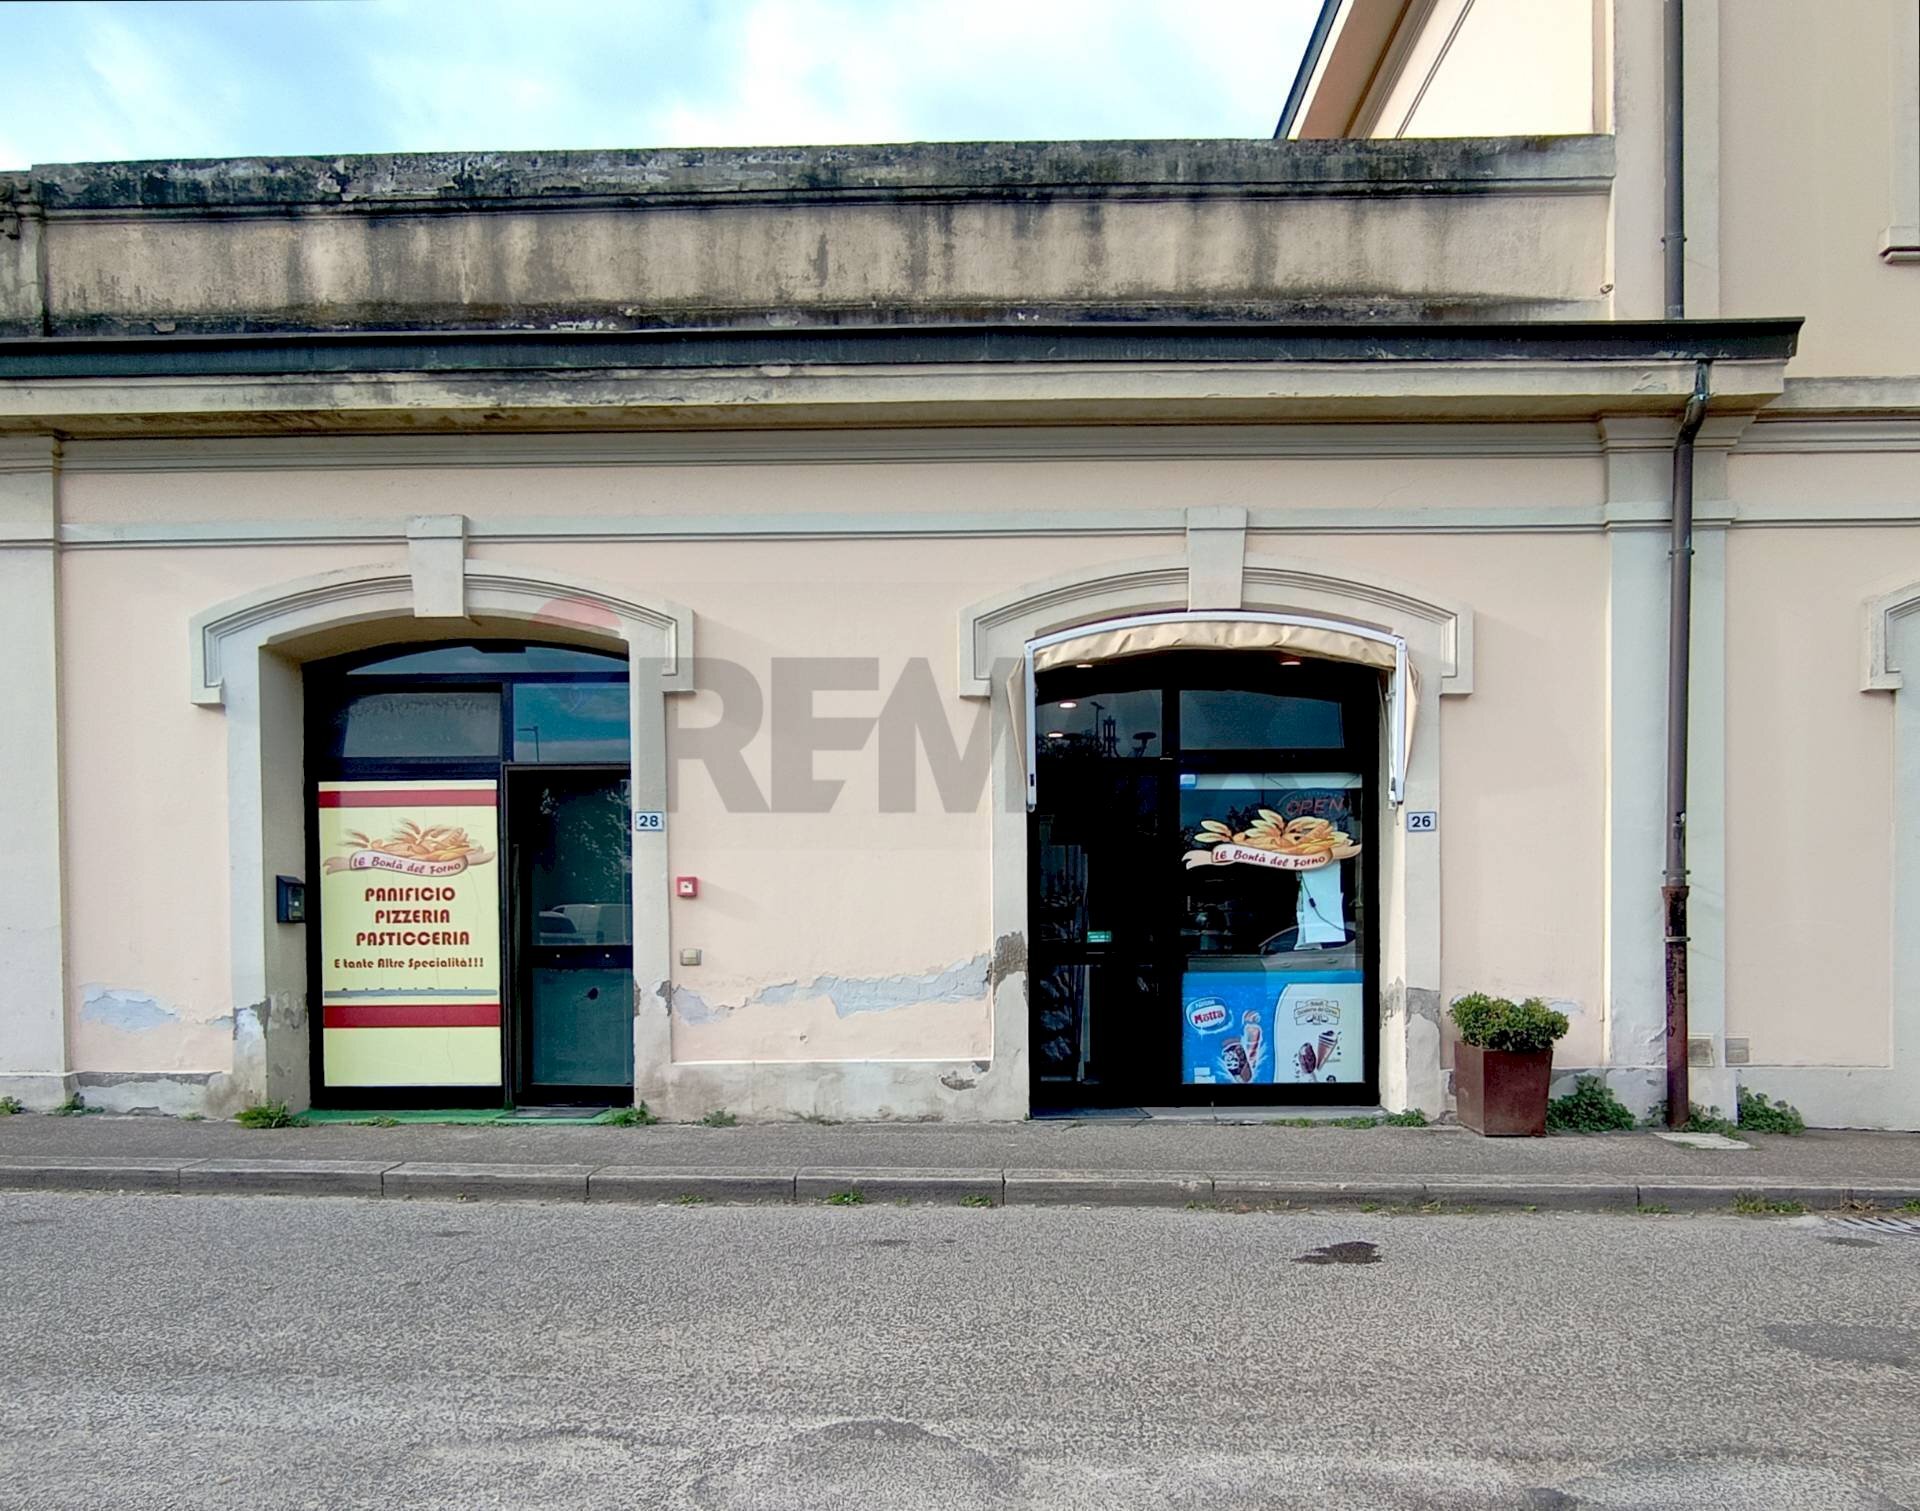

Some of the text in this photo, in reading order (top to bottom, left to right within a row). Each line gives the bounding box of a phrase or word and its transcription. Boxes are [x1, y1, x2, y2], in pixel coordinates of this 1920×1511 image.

[1286, 797, 1344, 815] OPEN
[639, 815, 659, 827] 28
[1412, 815, 1431, 828] 26
[1233, 849, 1266, 862] Bontà
[1270, 856, 1289, 867] del
[1293, 855, 1326, 867] Forno
[406, 863, 424, 874] del
[430, 863, 461, 875] Forno
[365, 887, 456, 901] PANIFICIO
[375, 909, 450, 924] PIZZERIA
[356, 931, 470, 946] PASTICCERIA
[334, 957, 484, 970] E tante Altre Specialità!!!
[1194, 1010, 1224, 1024] Motta
